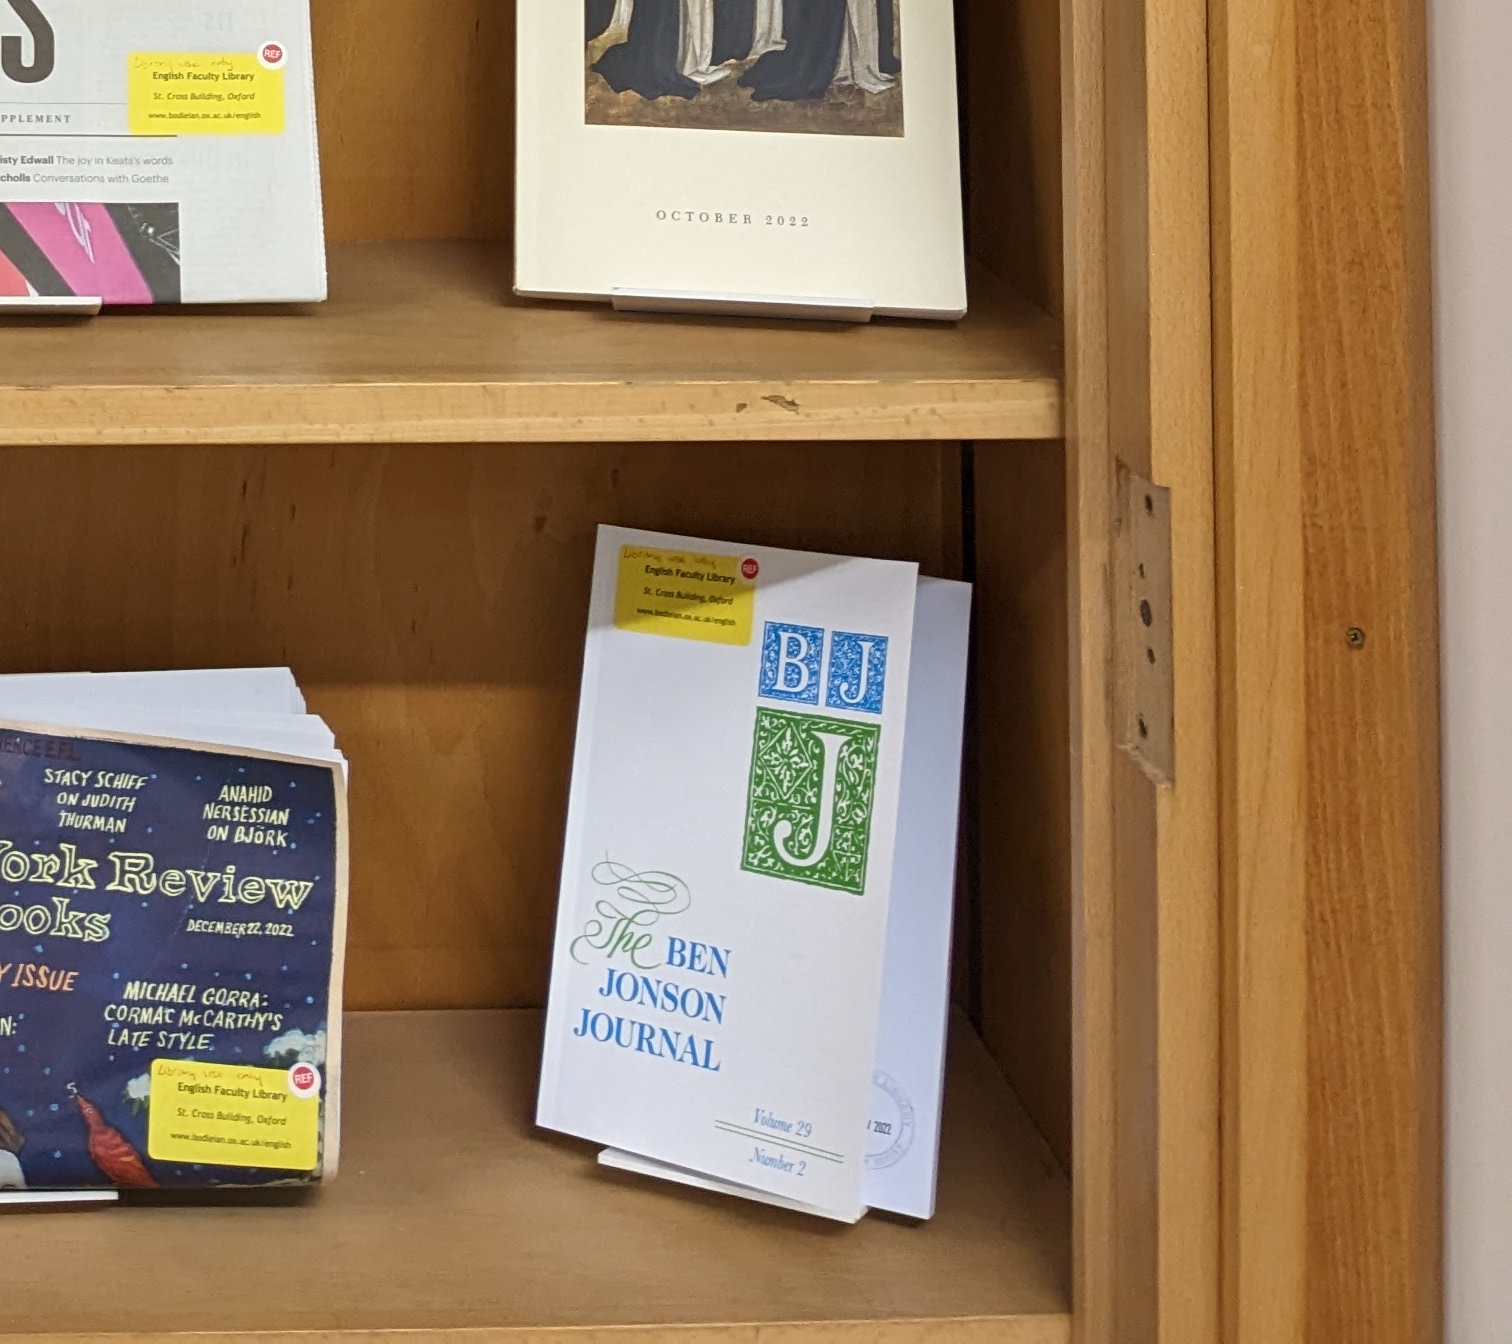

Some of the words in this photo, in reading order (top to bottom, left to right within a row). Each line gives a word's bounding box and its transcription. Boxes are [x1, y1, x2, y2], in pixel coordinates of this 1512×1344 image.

[152, 72, 187, 81] English
[190, 72, 218, 81] Faculty
[221, 72, 254, 81] Library
[656, 210, 753, 224] OCTOBER
[765, 215, 808, 227] 2022
[775, 629, 813, 693] B
[840, 640, 869, 703] J
[772, 732, 846, 866] J
[107, 851, 313, 910] Review
[666, 936, 732, 978] BEN
[12, 961, 79, 992] ISSUE
[123, 981, 197, 1003] MICHAEL
[202, 988, 269, 1008] GORRA:
[599, 967, 726, 1024] JONSON
[104, 1004, 175, 1025] CORMAC
[108, 1029, 153, 1047] LATE
[573, 1008, 721, 1071] JOURNAL
[177, 1083, 213, 1096] English
[215, 1085, 251, 1099] Faculty
[255, 1088, 287, 1102] Library
[294, 1072, 313, 1085] REF
[752, 1108, 793, 1133] Volume
[797, 1120, 813, 1137] 29
[749, 1147, 794, 1174] Number
[798, 1161, 806, 1175] 2
